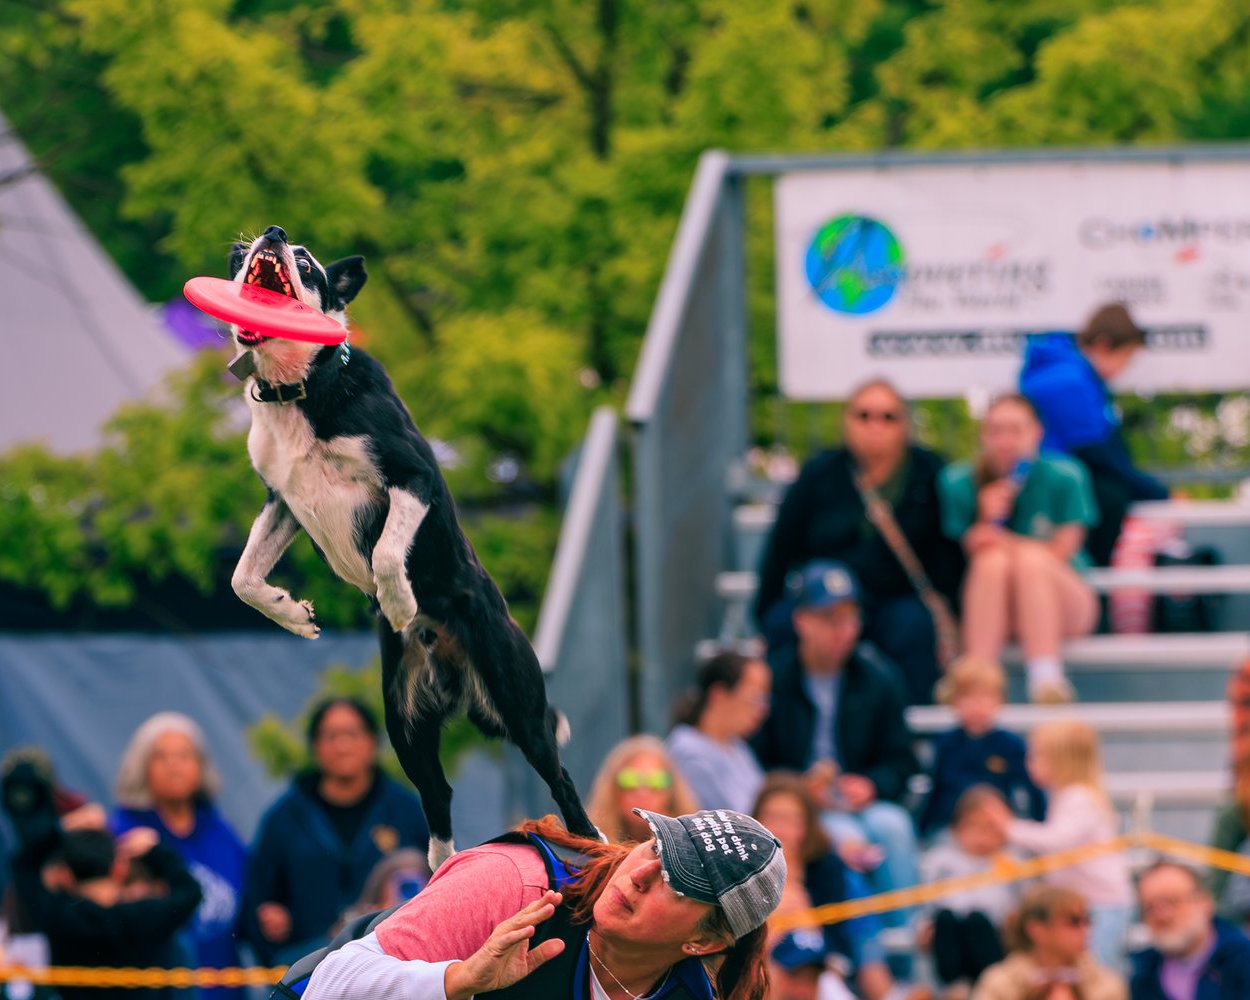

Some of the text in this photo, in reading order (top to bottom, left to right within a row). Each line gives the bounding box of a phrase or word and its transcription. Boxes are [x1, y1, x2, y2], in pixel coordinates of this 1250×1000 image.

[700, 832, 717, 852] dog
[716, 837, 734, 855] pet
[723, 821, 736, 835] my
[730, 835, 750, 861] drink
